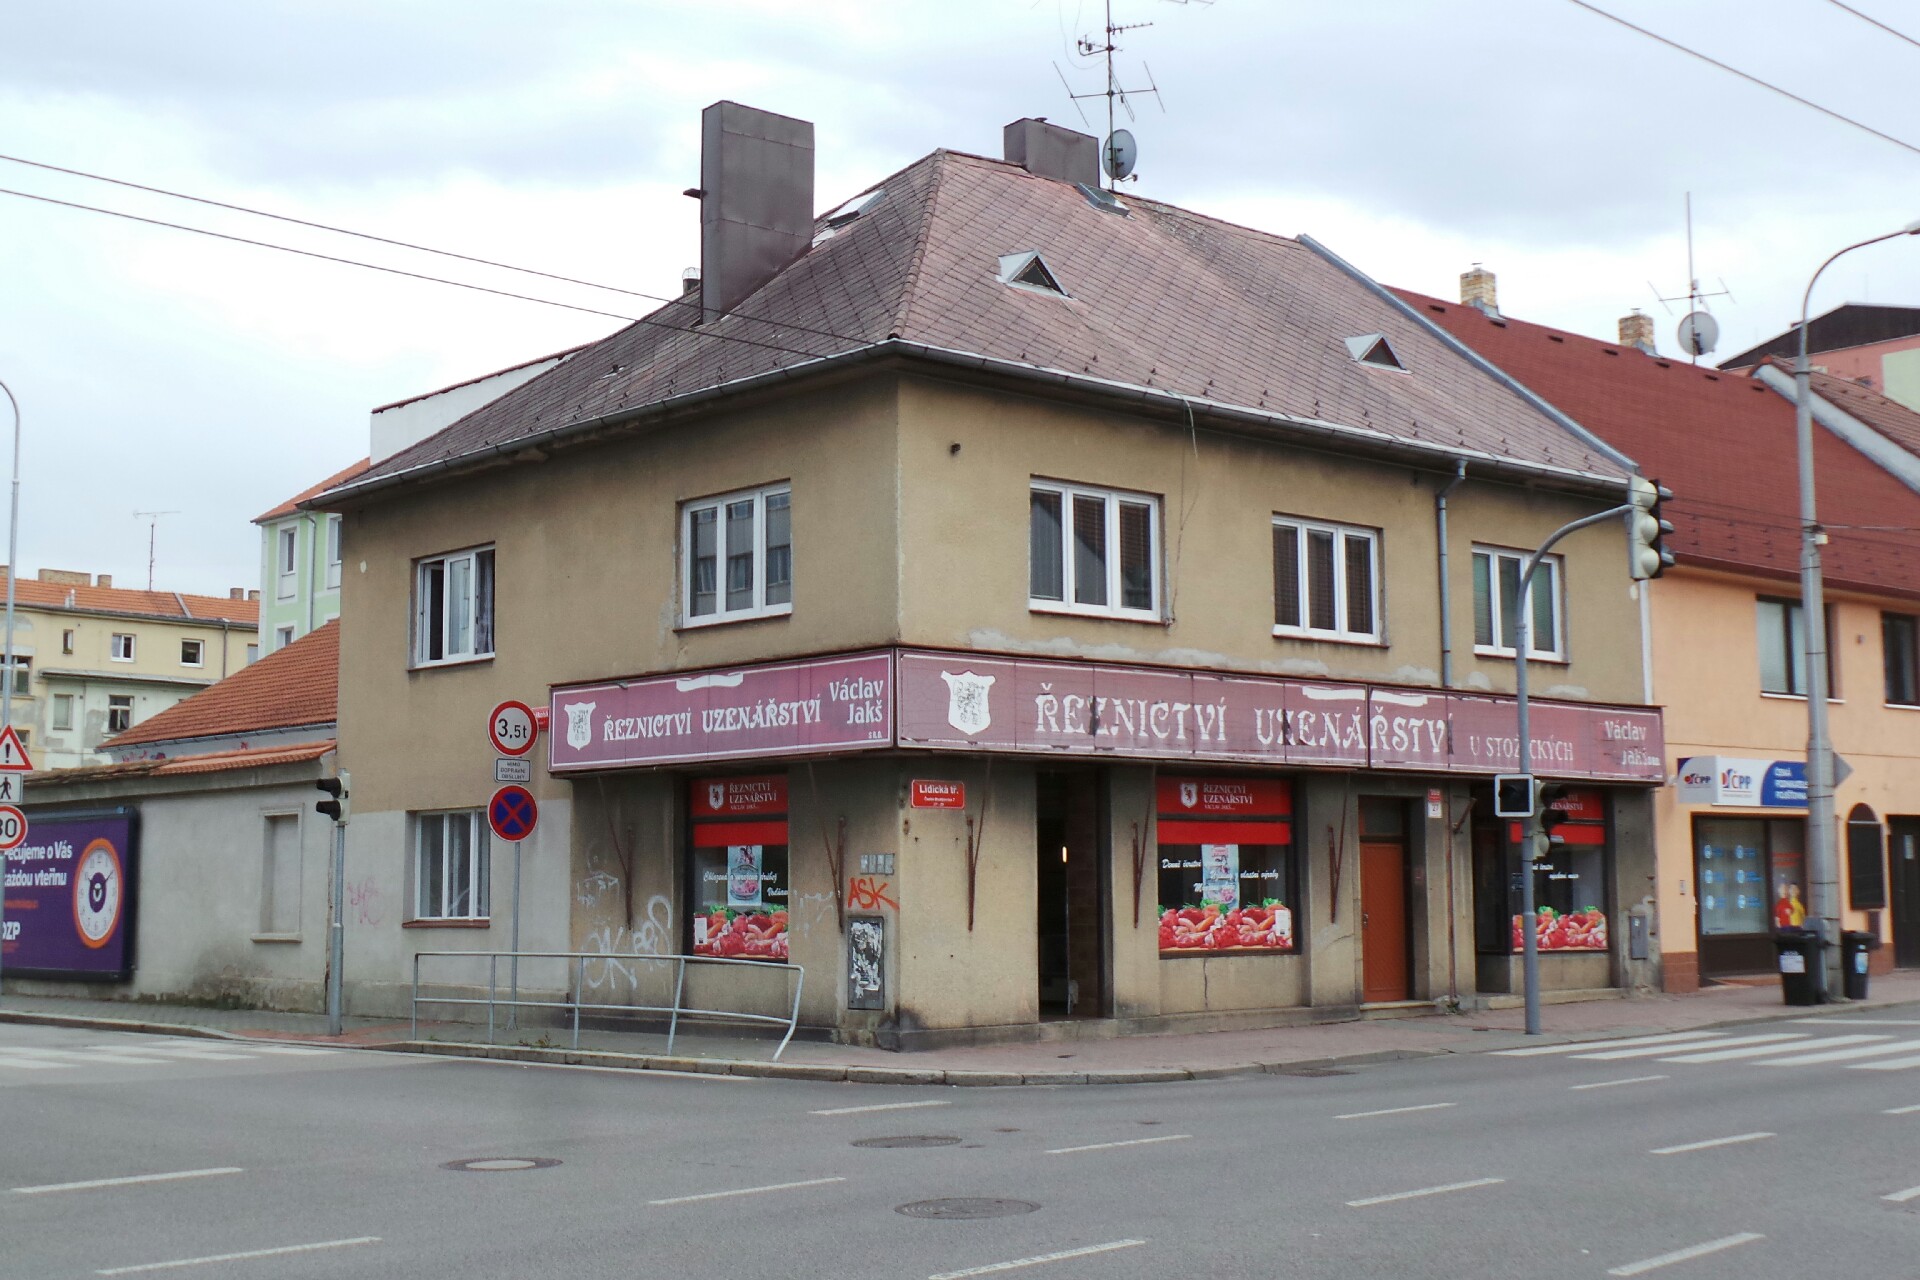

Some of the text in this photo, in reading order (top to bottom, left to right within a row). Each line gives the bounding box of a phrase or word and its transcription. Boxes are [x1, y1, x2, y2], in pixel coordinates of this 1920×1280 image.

[829, 678, 884, 703] Václav
[603, 694, 822, 741] ŘEZNICTVÍ UZENÁŘSTVÍ
[846, 701, 883, 725] Jakš
[1035, 682, 1227, 741] ŘEZNICTVÍ
[1604, 720, 1647, 741] Václav
[1469, 734, 1574, 762] U STOŽCKÝCH
[729, 780, 770, 793] ŘEZNICTVÍ
[1203, 783, 1246, 793] ŘEZNICTVÍ
[1731, 769, 1752, 789] ČPP
[729, 790, 777, 804] UZENÁŘSTVÍ
[919, 784, 959, 795] Lidická tř.
[1203, 793, 1253, 804] UZENÁŘSTVÍ
[0, 818, 17, 838] 0
[46, 847, 53, 859] o
[54, 840, 73, 859] Vás
[4, 867, 67, 887] aždou vteřinu
[848, 877, 900, 910] ASK
